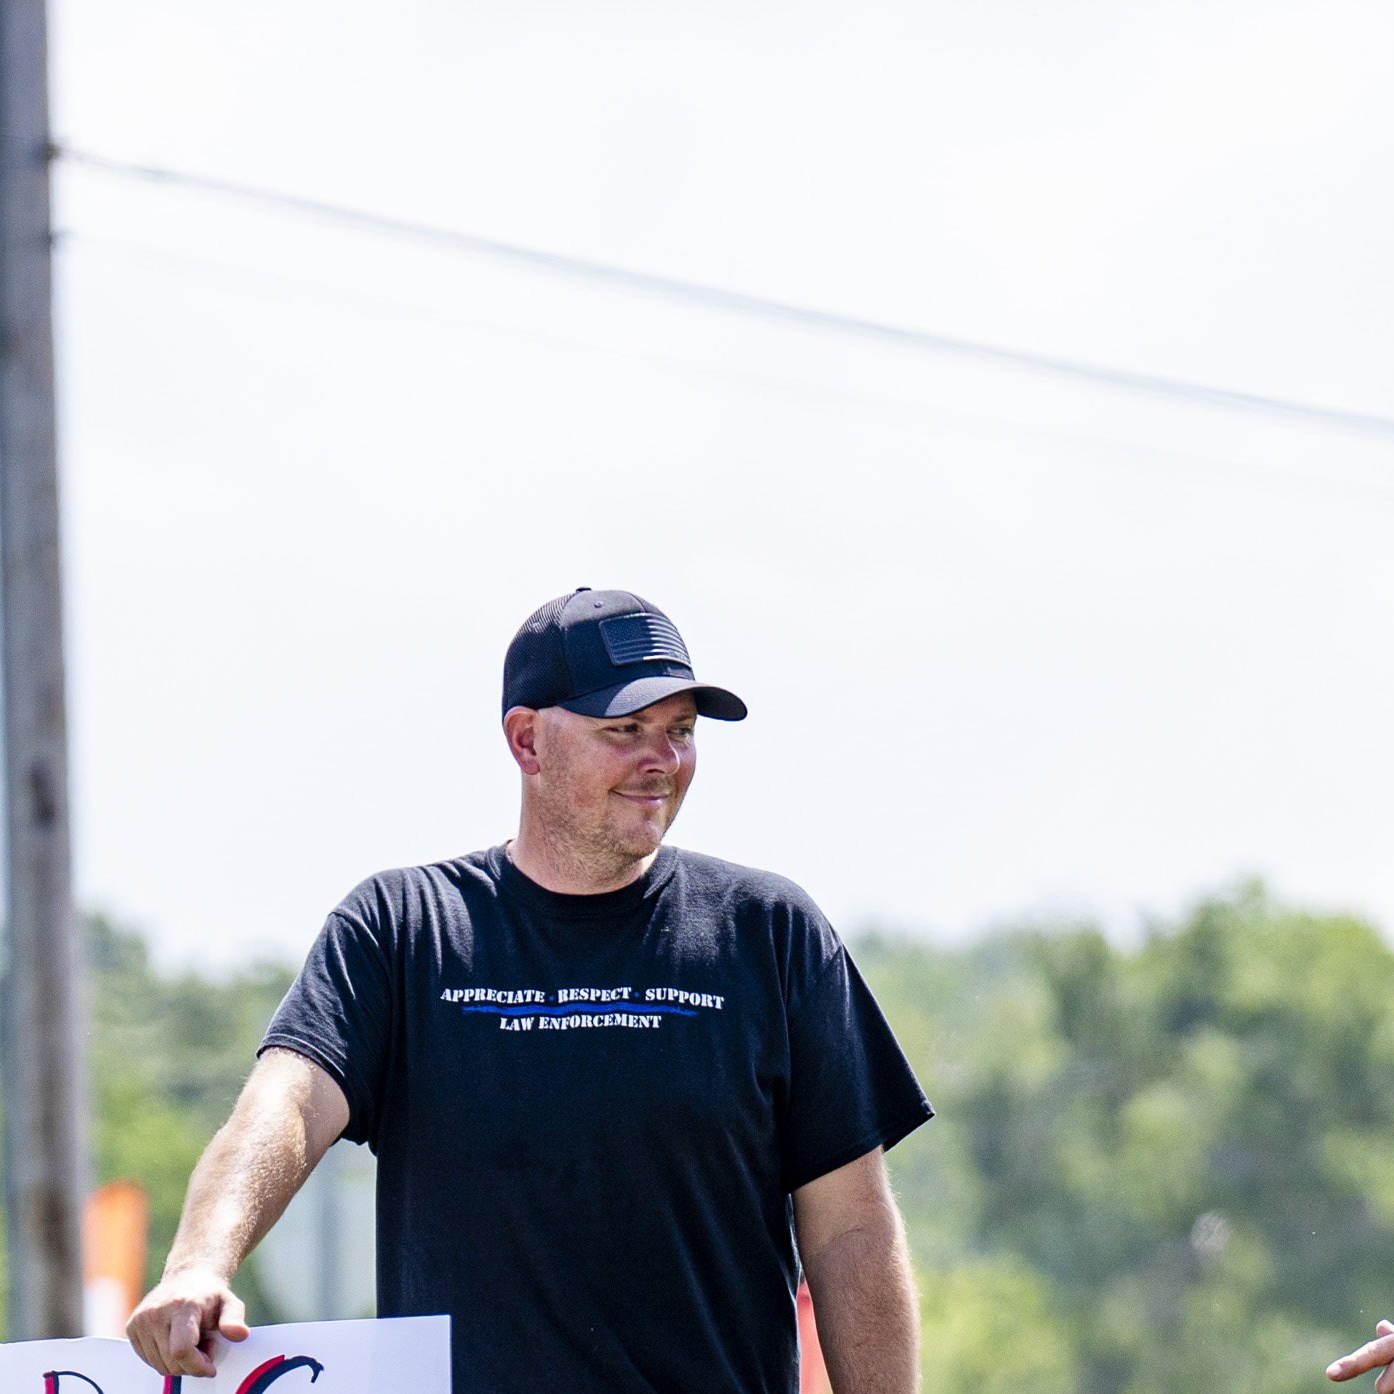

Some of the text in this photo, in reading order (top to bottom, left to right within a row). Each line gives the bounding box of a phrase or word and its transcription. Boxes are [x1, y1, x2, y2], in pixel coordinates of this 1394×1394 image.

[439, 986, 725, 1010] APPRECIATE RESPECT SUPPORT
[499, 1013, 663, 1031] LAW ENFORCEMENT
